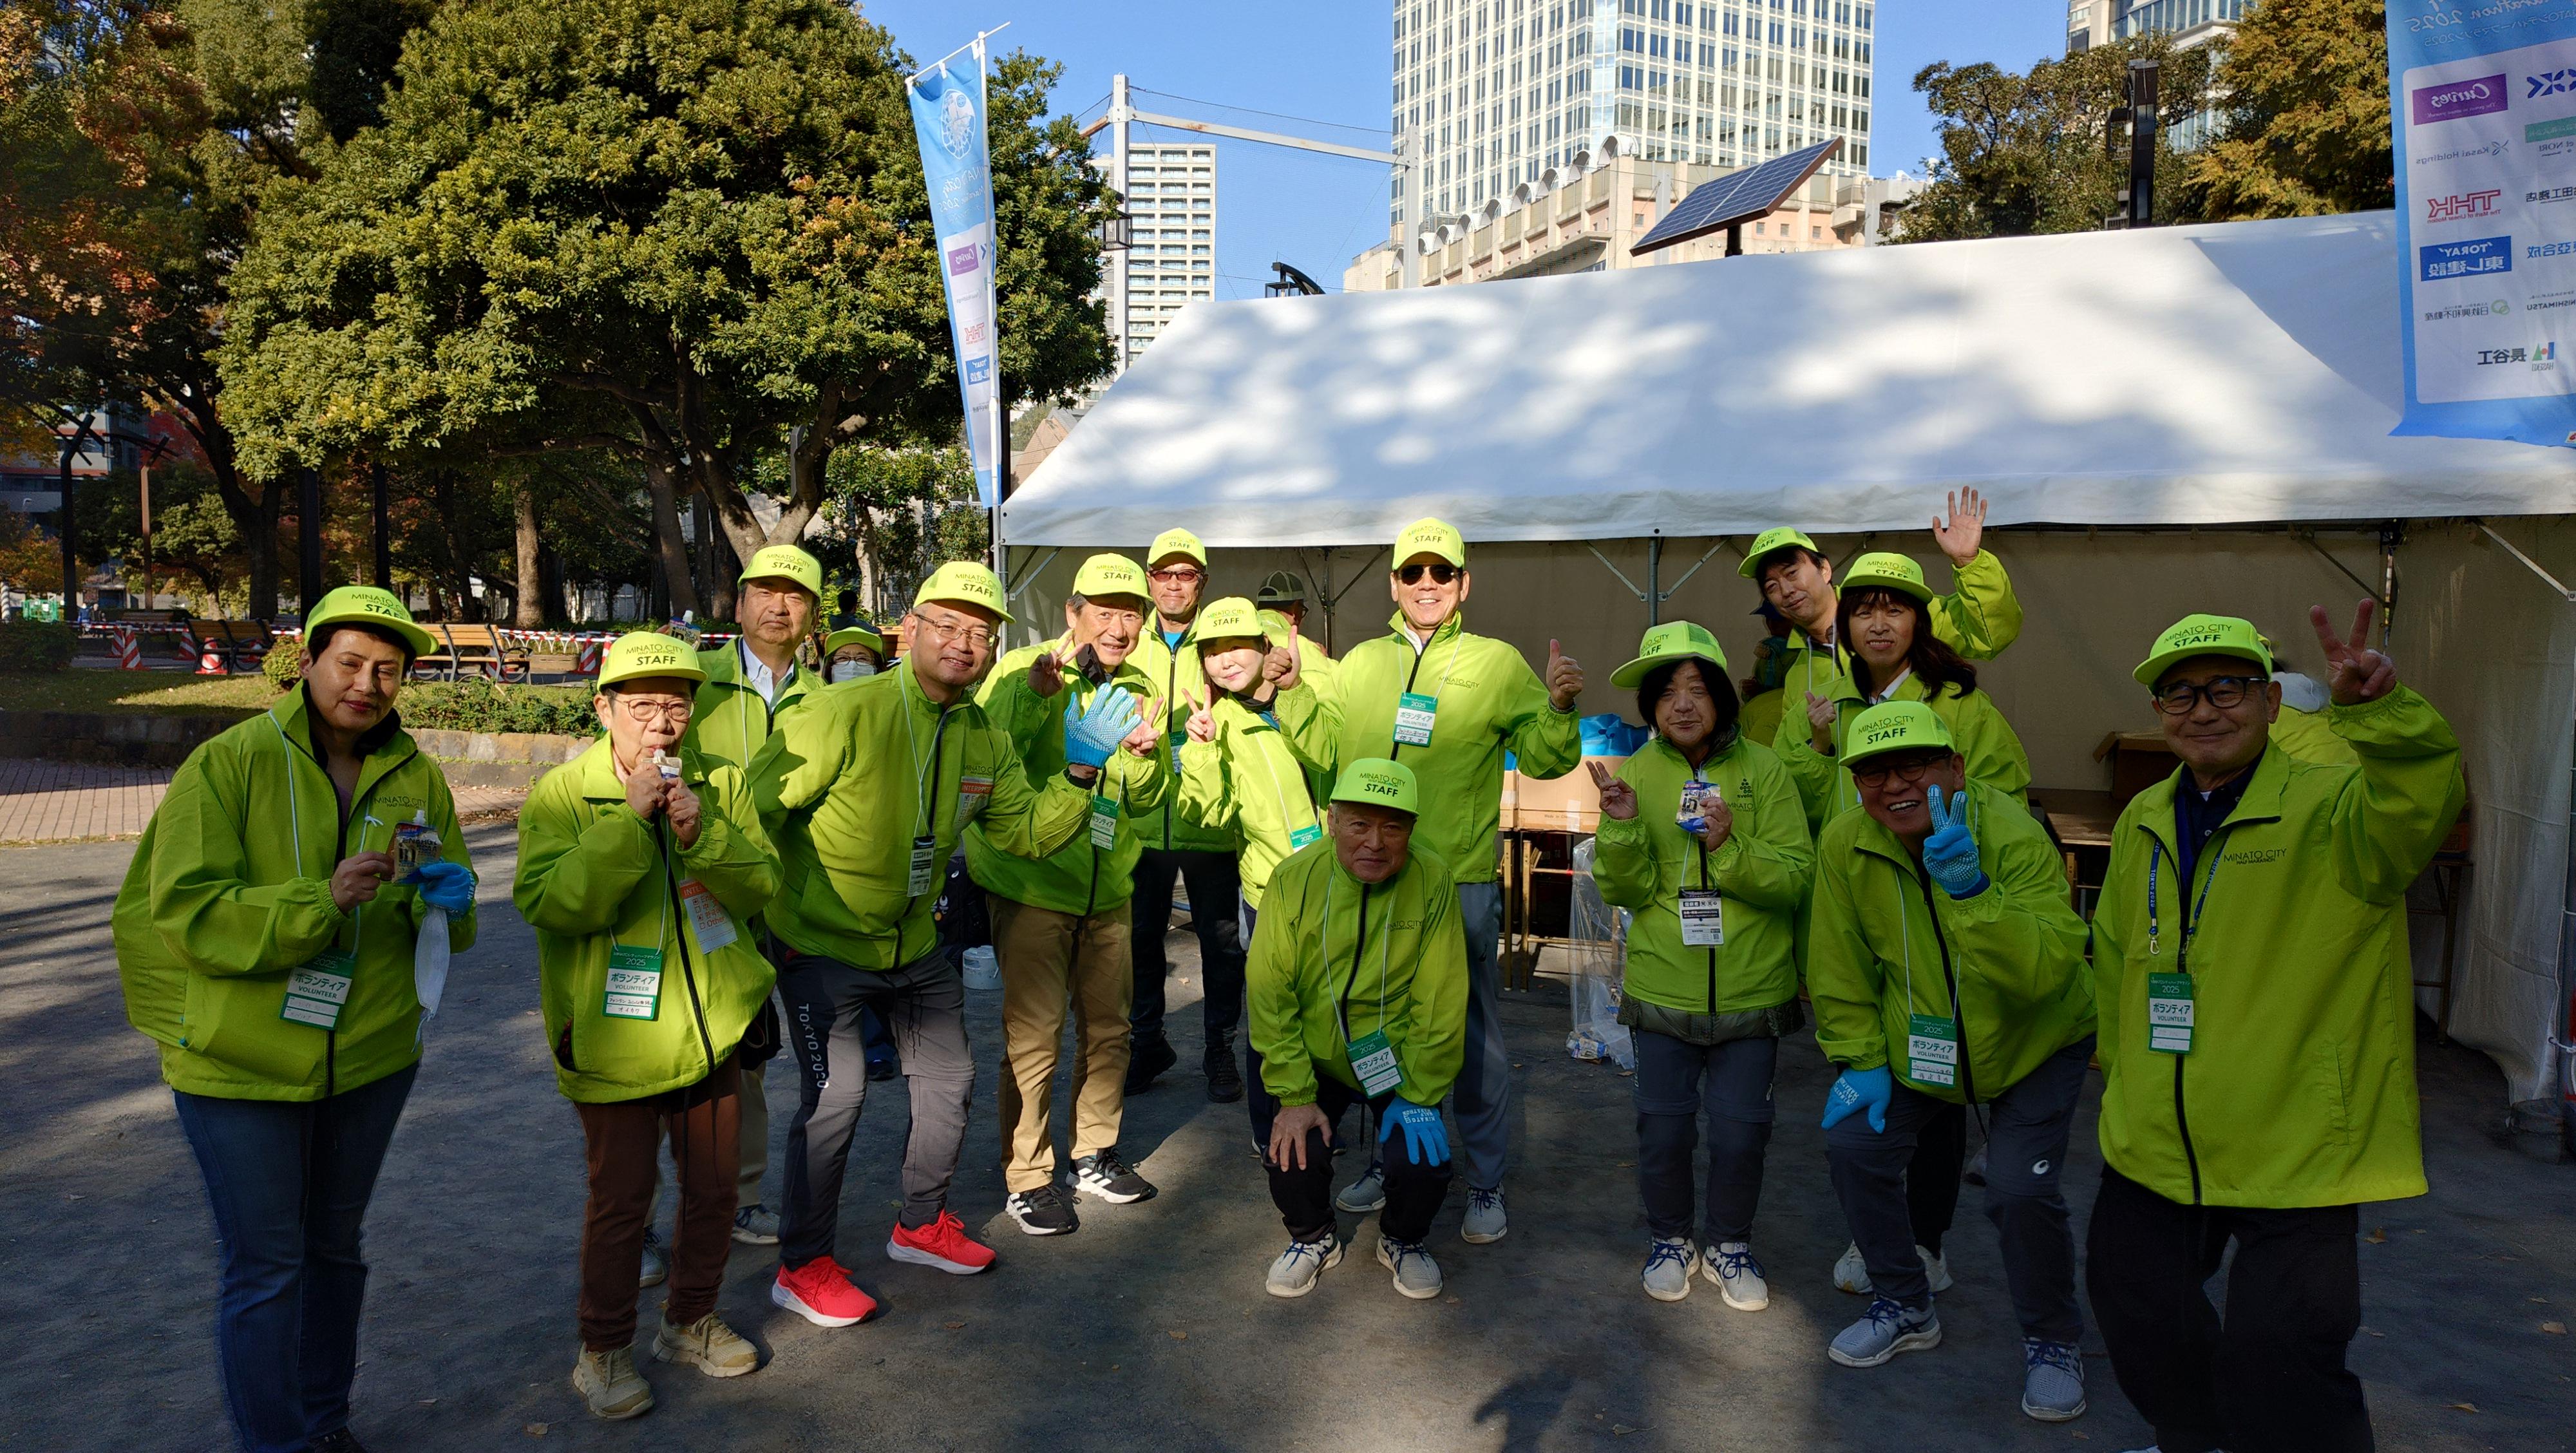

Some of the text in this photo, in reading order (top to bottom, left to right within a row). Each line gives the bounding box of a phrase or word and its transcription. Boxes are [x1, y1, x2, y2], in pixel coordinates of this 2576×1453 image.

[772, 562, 803, 573] STAFF
[954, 573, 987, 583] MINATO
[1103, 572, 1133, 581] STAFF
[962, 584, 994, 598] STAFF
[351, 594, 393, 606] MINATO
[1213, 618, 1240, 627] STAFF
[2164, 623, 2232, 643] MINATO CITY
[2174, 634, 2221, 648] STAFF
[626, 644, 684, 655] MINATO CITY
[636, 656, 677, 665] STAFF
[1401, 712, 1432, 722] ボランティア
[1858, 716, 1915, 734] MINATO CITY
[1867, 728, 1906, 745] STAFF
[1359, 773, 1406, 786] MINATO CITY
[1364, 783, 1398, 797] STAFF
[375, 796, 426, 807] MINATO CITY
[2224, 848, 2287, 862] MINATO CITY
[314, 957, 338, 969] 2025
[295, 973, 346, 991] ボランティア
[611, 973, 656, 985] ボランティア
[298, 985, 337, 999] VOLUNTEER
[2153, 1003, 2190, 1014] ボランティア
[1924, 1025, 1943, 1034] 2025
[798, 1003, 829, 1088] TOKYO 2020
[1359, 1044, 1376, 1054] 2025
[1913, 1040, 1954, 1053] ボランティア
[1917, 1050, 1949, 1059] VOLUNTEER
[1356, 1051, 1389, 1072] ボランティア
[1363, 1061, 1390, 1075] VOLUNTEER
